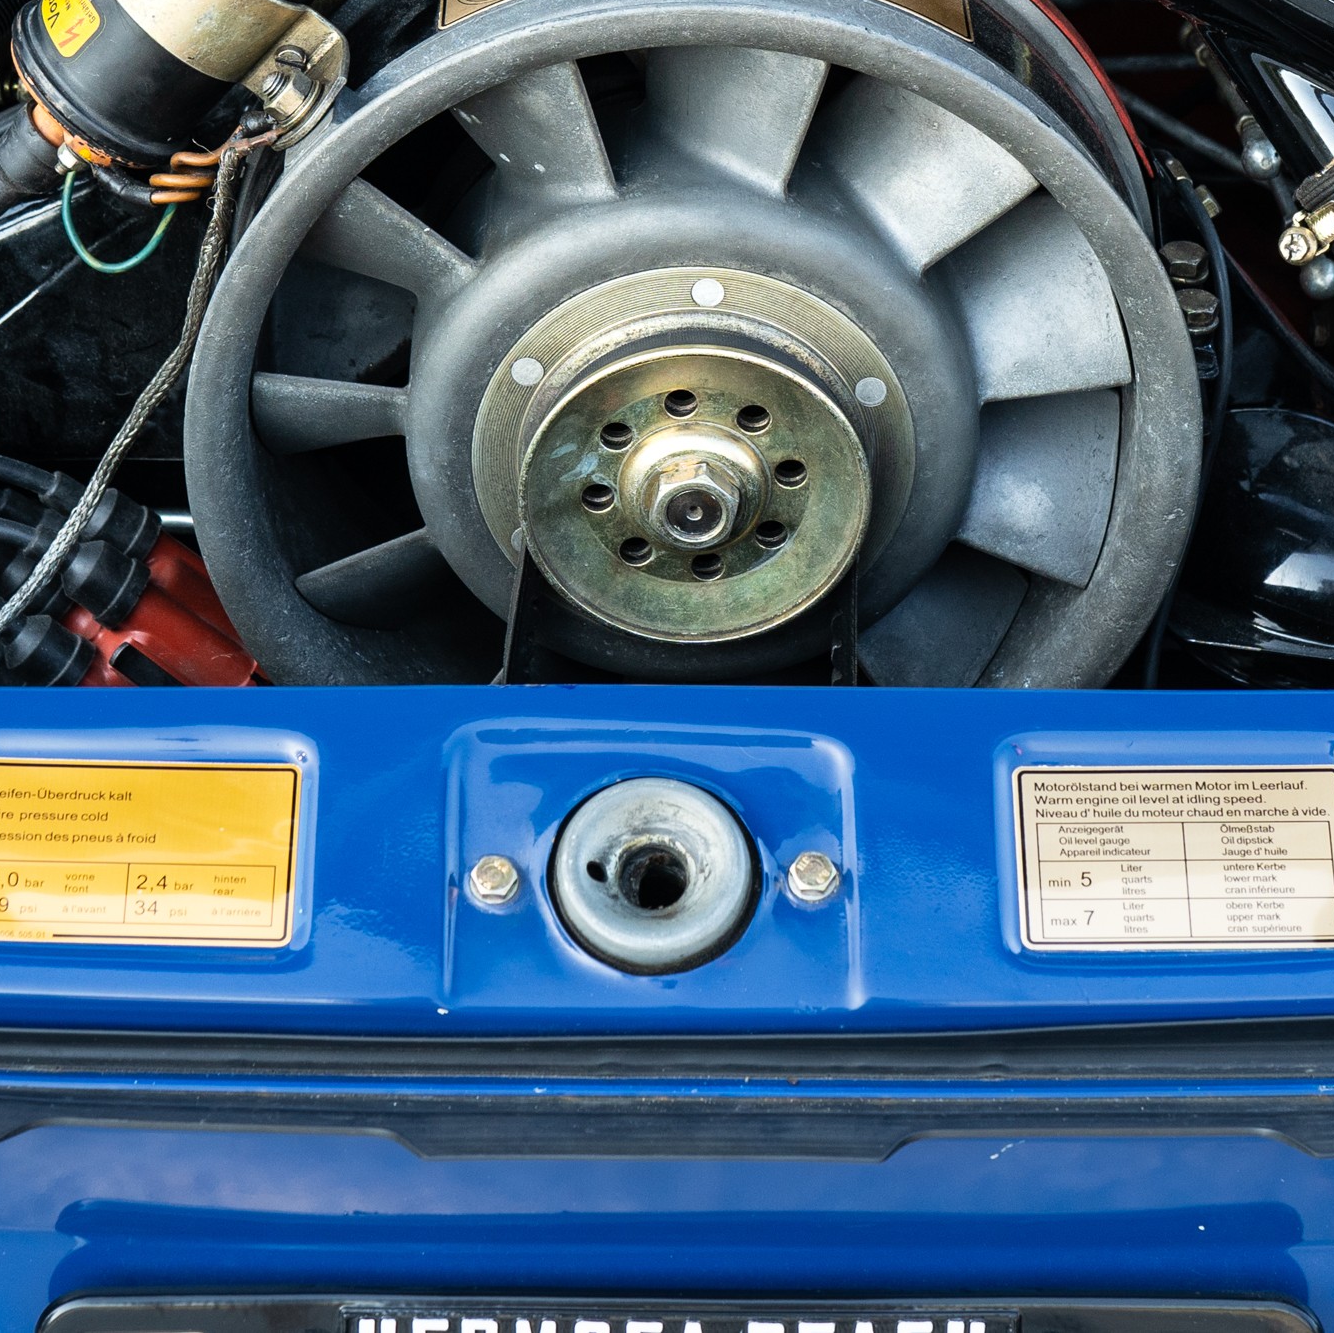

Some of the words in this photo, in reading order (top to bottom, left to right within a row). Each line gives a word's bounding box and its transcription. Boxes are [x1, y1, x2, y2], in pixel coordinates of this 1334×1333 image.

[1033, 781, 1117, 792] Motorölstand
[1119, 781, 1139, 791] bei
[1140, 783, 1193, 791] warmen
[1195, 781, 1232, 791] Motor
[108, 790, 132, 801] kalt
[1034, 795, 1073, 805] Warm
[1075, 797, 1119, 807] engine
[1121, 794, 1137, 805] oil
[1139, 794, 1169, 804] level
[1171, 794, 1184, 804] at
[1186, 794, 1221, 806] idling
[19, 812, 78, 822] pressure
[80, 811, 109, 822] cold
[1035, 808, 1078, 818] Niveau
[1092, 808, 1122, 818] huile
[1123, 808, 1140, 818] du
[1141, 808, 1184, 818] moteur
[1186, 807, 1224, 817] chaud
[1225, 809, 1241, 817] en
[1243, 807, 1289, 817] marche
[45, 831, 69, 842] des
[71, 834, 113, 844] pneus
[127, 832, 157, 844] froid
[1058, 836, 1073, 845] Oil
[1074, 836, 1098, 845] level
[1099, 838, 1130, 847] gauge
[1220, 835, 1235, 845] Oil
[1236, 835, 1274, 846] dipstick
[1059, 847, 1101, 858] Appareil
[1102, 847, 1151, 856] indicateur
[1222, 847, 1252, 858] Jauge
[1263, 847, 1288, 856] huile
[1120, 863, 1142, 872] Liter
[1223, 863, 1255, 871] untere
[1256, 862, 1286, 871] Kerbe
[24, 878, 45, 888] bar
[136, 874, 167, 892] 2,4
[174, 881, 194, 891] bar
[1048, 879, 1071, 887] min
[1081, 871, 1092, 887] 5
[1121, 875, 1153, 886] quarts
[1223, 874, 1250, 883] lower
[1252, 873, 1277, 882] mark
[1122, 887, 1146, 895] litres
[134, 899, 158, 915] 34
[1122, 902, 1145, 911] Liter
[1225, 901, 1253, 910] obere
[1256, 900, 1285, 909] Kerbe
[1050, 918, 1077, 926] max
[1083, 910, 1095, 926] 7
[1123, 913, 1155, 924] quarts
[1226, 914, 1254, 923] upper
[1257, 912, 1281, 921] mark
[1123, 925, 1149, 934] litres
